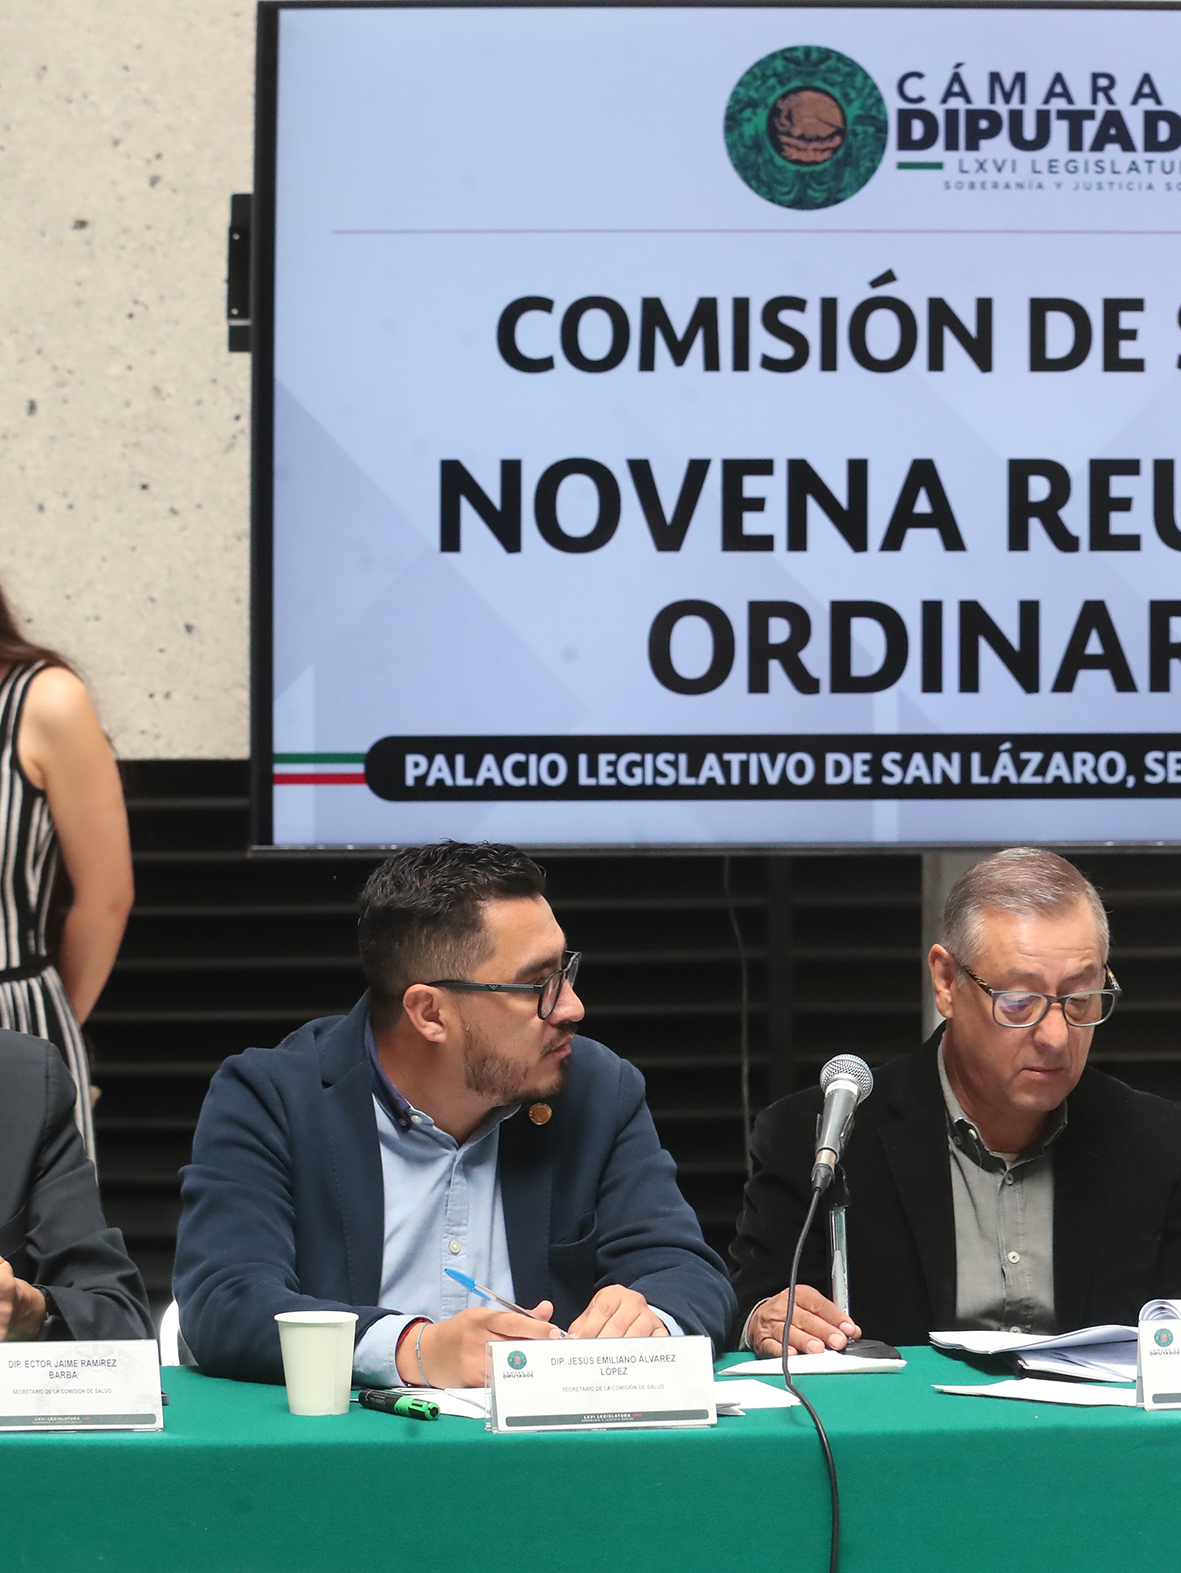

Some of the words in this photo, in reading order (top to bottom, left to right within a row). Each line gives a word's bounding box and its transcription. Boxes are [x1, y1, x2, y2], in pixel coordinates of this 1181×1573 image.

[896, 62, 1163, 106] CÁMARA
[959, 159, 1016, 174] LXVI
[943, 179, 1046, 192] SOBERANÍA
[1055, 181, 1063, 191] Y
[1073, 181, 1156, 192] JUSTICIA
[496, 269, 993, 374] COMISIÓN
[1029, 297, 1145, 373] DE
[440, 457, 967, 554] NOVENA
[405, 753, 567, 787] PALACIO
[578, 752, 815, 786] LEGISLATIVO
[825, 752, 872, 785] DE
[881, 751, 960, 785] SAN
[971, 742, 1136, 788] LÁZARO,
[8, 1360, 23, 1368] DIP.
[25, 1358, 52, 1368] ÉCTOR
[54, 1360, 78, 1368] JAIME
[81, 1358, 117, 1367] RAMÍREZ
[551, 1357, 566, 1366] DIP.
[568, 1355, 594, 1365] JESÚS
[597, 1355, 636, 1364] EMILIANO
[639, 1353, 676, 1363] ÁLVAREZ
[49, 1371, 78, 1379] BARBA
[600, 1366, 628, 1376] LÓPEZ
